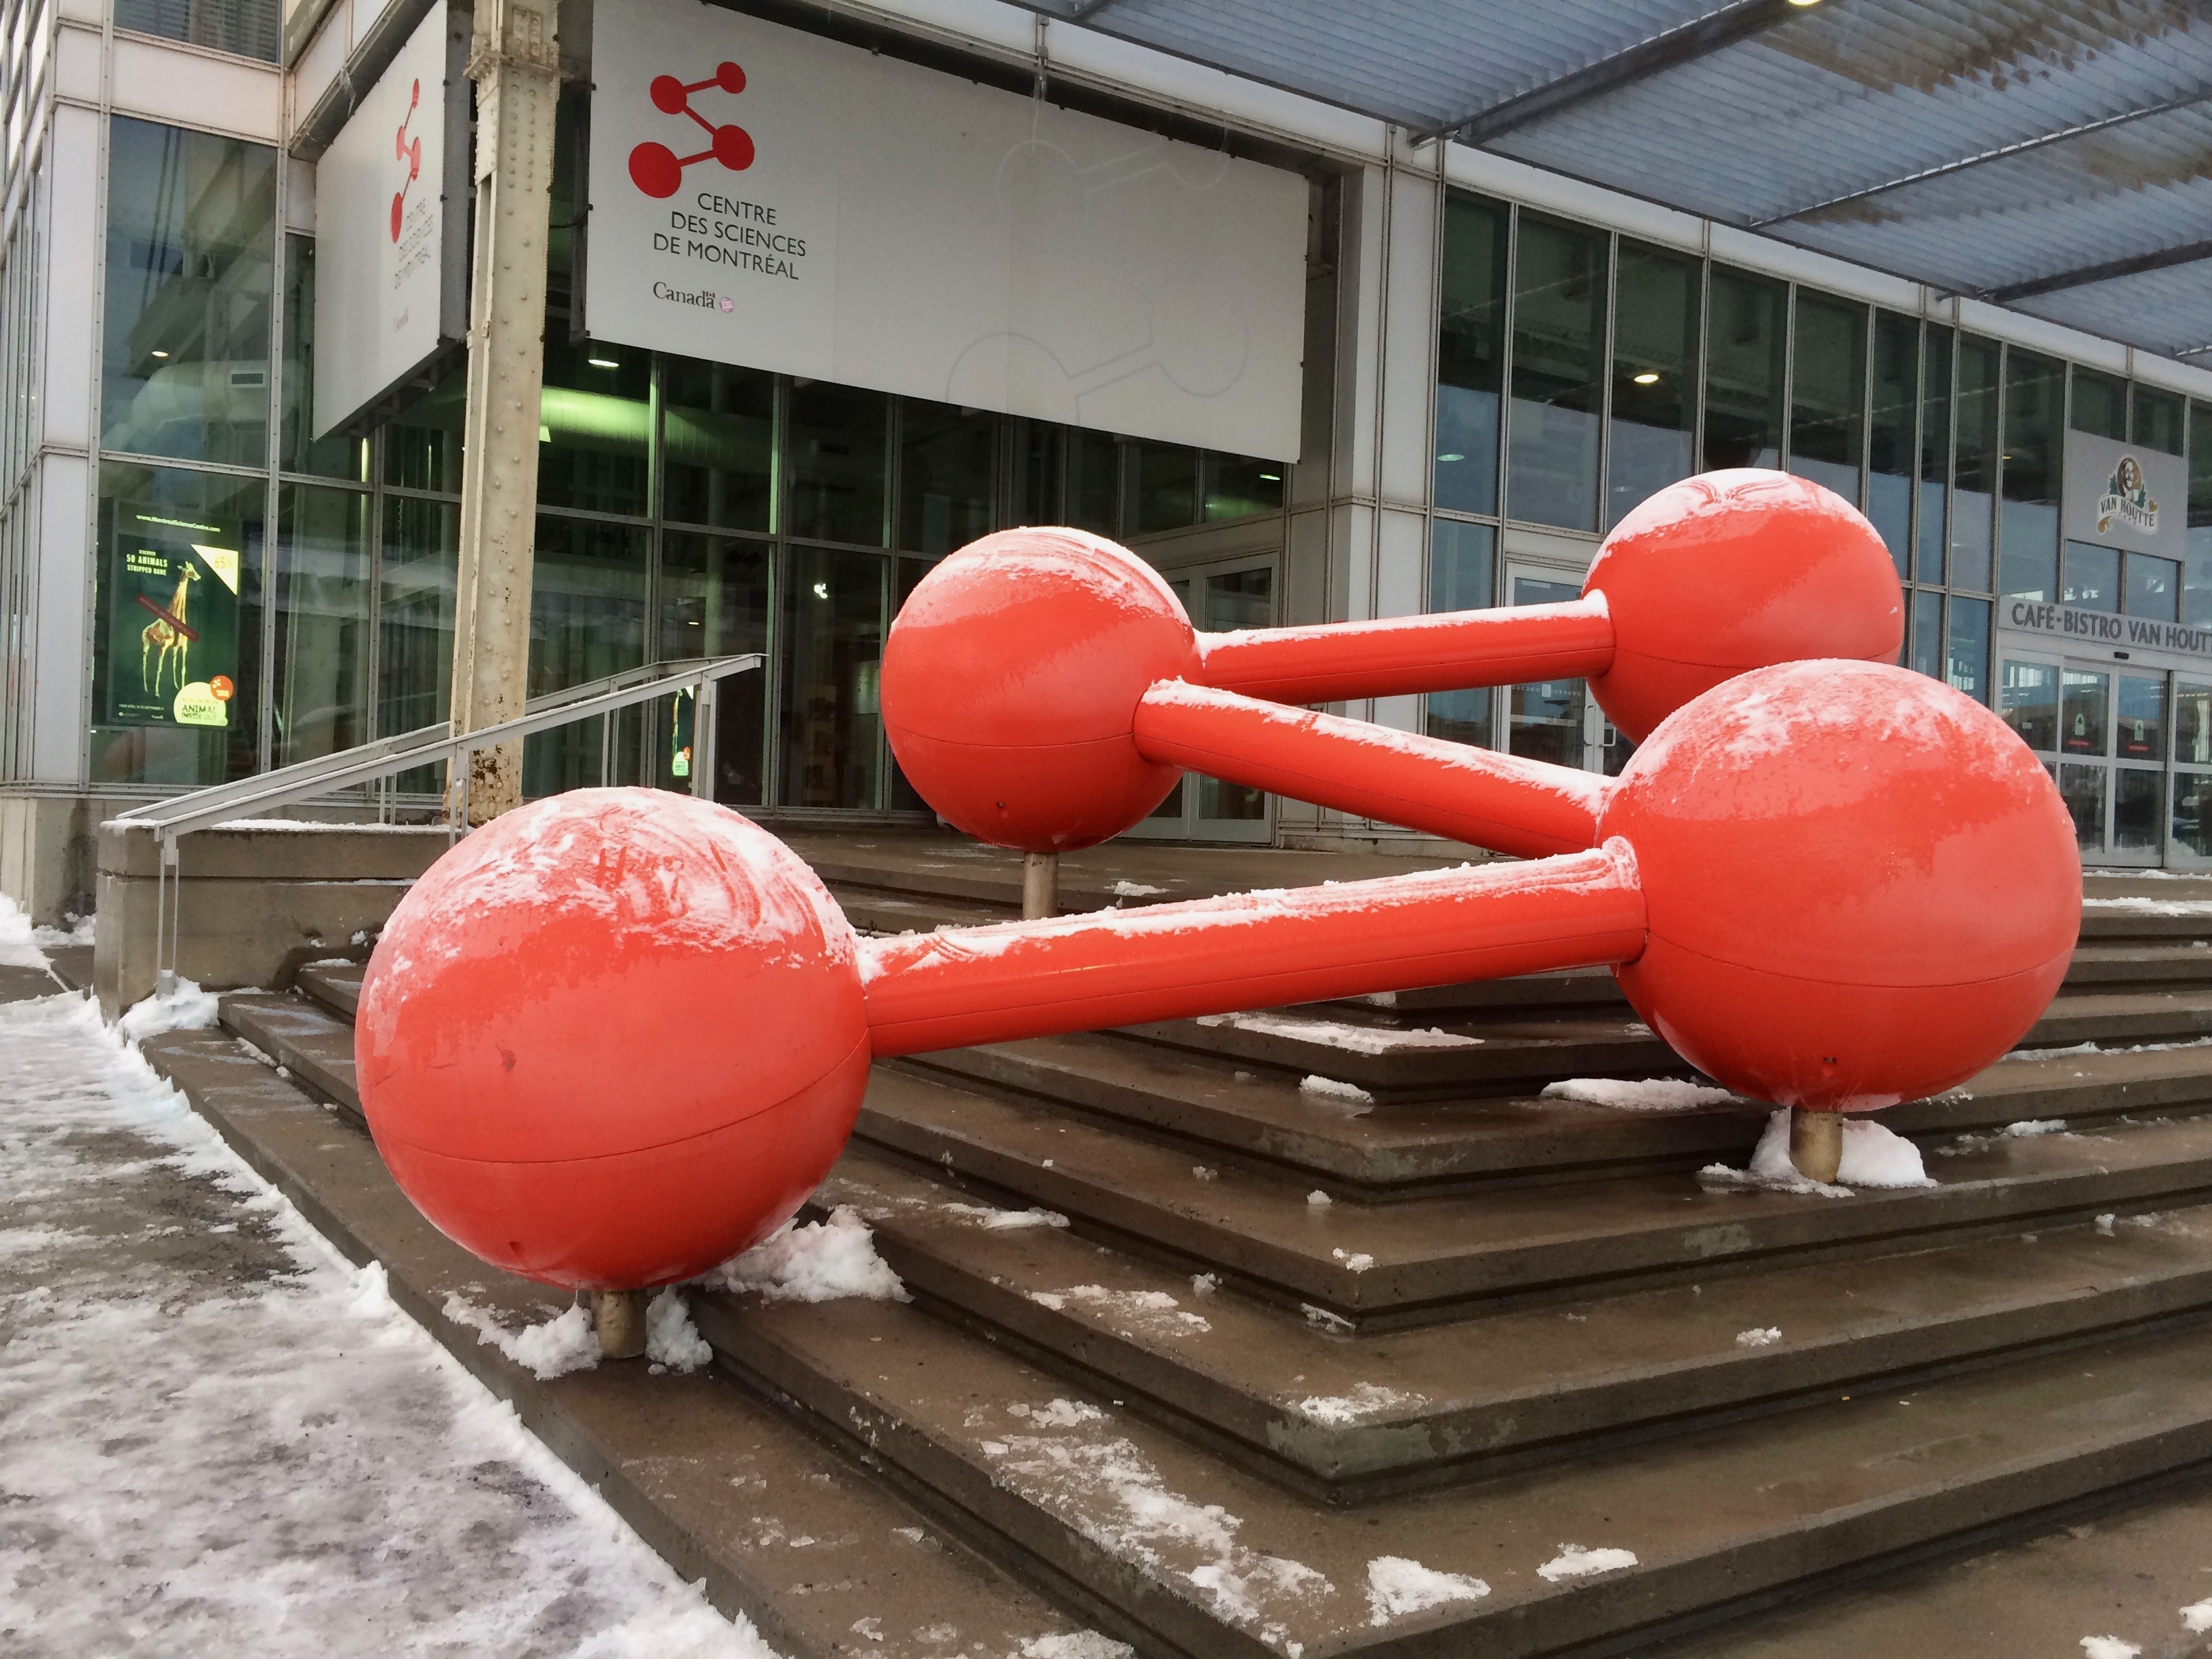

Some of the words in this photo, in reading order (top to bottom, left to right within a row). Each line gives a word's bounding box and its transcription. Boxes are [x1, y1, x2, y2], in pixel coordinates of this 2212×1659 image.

[697, 192, 777, 226] CENTRE
[671, 211, 708, 234] DES
[714, 221, 806, 257] SCIENCES
[653, 232, 680, 255] DE
[687, 239, 800, 281] MONTRÉAL
[653, 281, 716, 310] Canada
[2100, 496, 2117, 514] VAN
[2120, 498, 2155, 527] HOUTTE
[126, 554, 136, 563] 50
[138, 556, 168, 568] ANIMALS
[127, 564, 152, 574] STRIPPED
[2011, 602, 2122, 640] CAFÉ-BISTRO
[2129, 619, 2161, 646] VAN
[182, 704, 216, 714] ANIMAL
